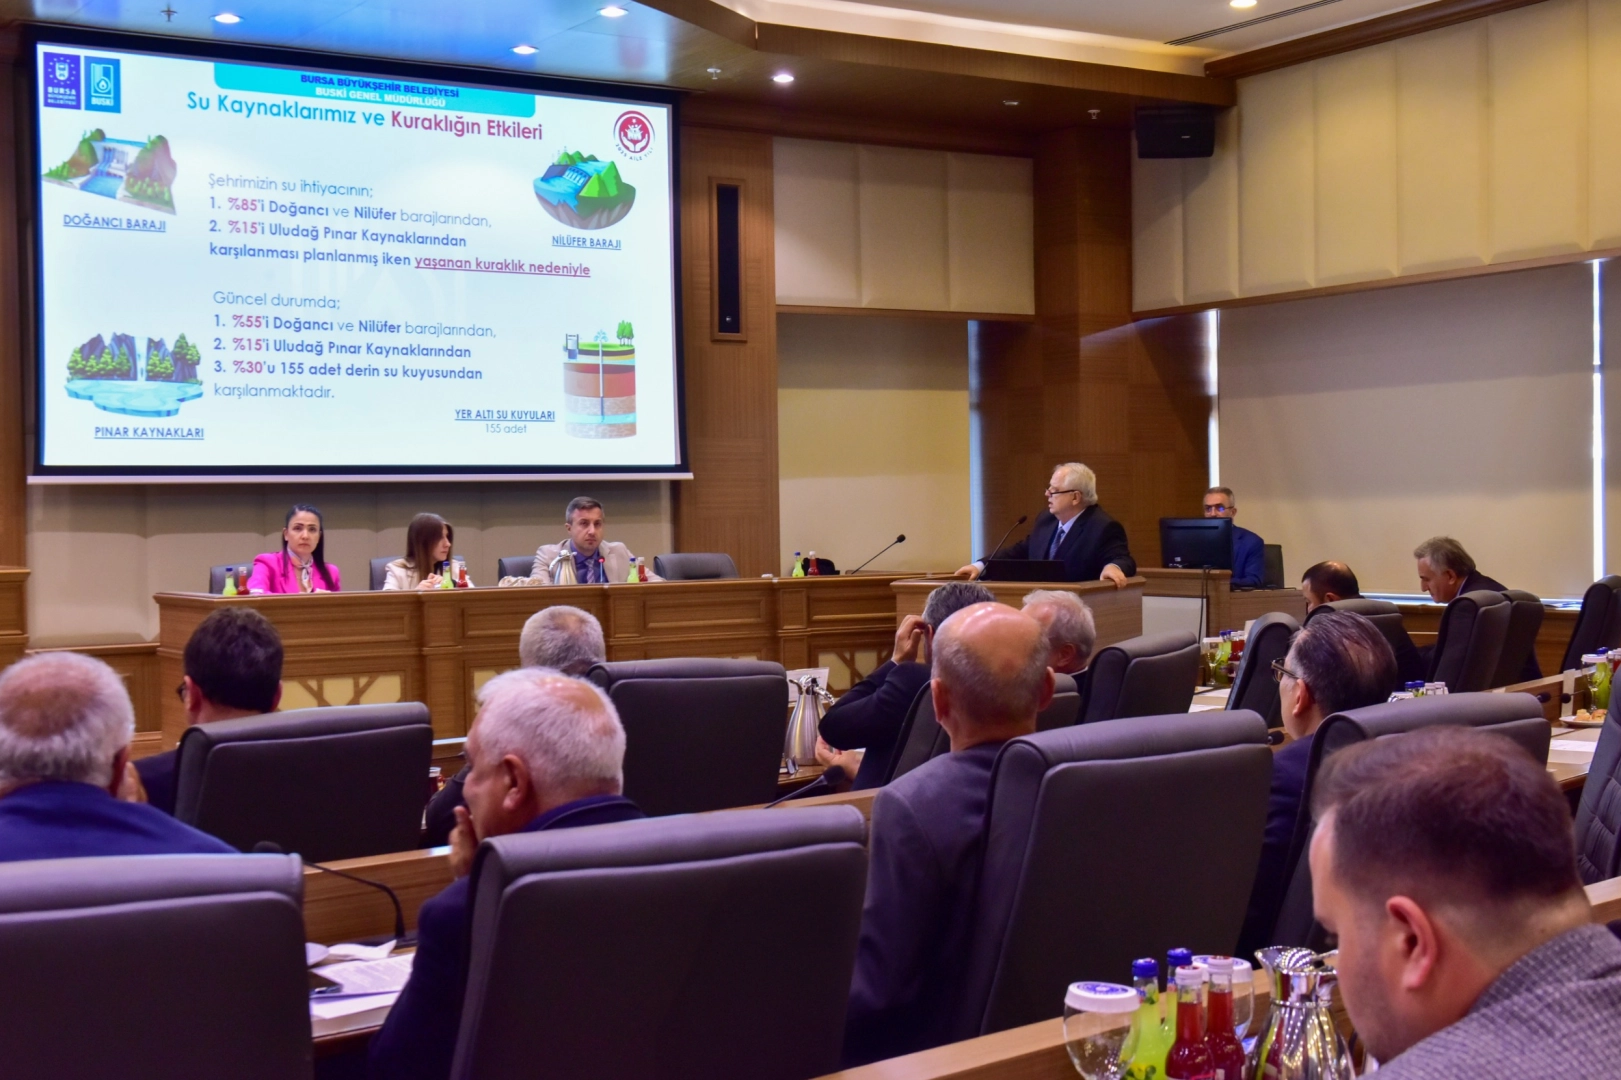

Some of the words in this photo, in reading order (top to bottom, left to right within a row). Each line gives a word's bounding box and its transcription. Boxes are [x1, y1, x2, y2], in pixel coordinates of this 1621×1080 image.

[301, 74, 335, 86] BURSA
[337, 78, 402, 92] BÜYÜKŞEHİR
[404, 84, 460, 98] BELEDİYESİ
[315, 87, 347, 98] BUSKİ
[349, 90, 382, 102] GENEL
[384, 93, 446, 107] MÜDÜRLÜĞÜ
[186, 90, 210, 110] Su
[218, 94, 357, 123] Kaynaklarımız
[363, 111, 386, 127] ve
[392, 110, 480, 138] Kuraklığın
[488, 120, 542, 140] Etkileri
[208, 172, 278, 190] Şehrimizin
[282, 182, 296, 192] su
[300, 180, 374, 198] ihtiyacının;
[270, 200, 328, 218] Doğancı
[332, 208, 350, 218] ve
[354, 206, 396, 220] Nilüfer
[63, 214, 123, 228] DOĞANCI
[126, 218, 166, 231] BARAJI
[270, 222, 320, 242] Uludağ
[324, 226, 358, 240] Pınar
[362, 228, 466, 248] Kaynaklarından
[552, 235, 587, 247] NİLÜFER
[590, 237, 621, 249] BARAJI
[210, 242, 298, 260] karşılanması
[304, 248, 378, 266] planlanmış
[382, 252, 410, 266] iken
[414, 256, 472, 270] yaşanan
[475, 257, 526, 272] kuraklık
[529, 261, 591, 276] nedeniyle
[212, 290, 266, 306] Güncel
[270, 294, 340, 310] durumda;
[274, 316, 334, 332] Doğancı
[336, 322, 354, 332] ve
[358, 320, 402, 334] Nilüfer
[404, 320, 496, 338] barajlarından,
[274, 338, 324, 356] Uludağ
[328, 340, 362, 354] Pınar
[366, 342, 472, 358] Kaynaklarından
[280, 362, 304, 374] 155
[308, 362, 342, 376] adet
[346, 364, 380, 376] derin
[384, 368, 398, 378] su
[402, 364, 482, 380] kuyusundan
[214, 382, 334, 400] karşılanmaktadır.
[455, 409, 472, 419] YER
[475, 409, 494, 419] ALTI
[496, 410, 508, 420] SU
[510, 410, 555, 420] KUYULARI
[95, 427, 129, 437] PINAR
[133, 427, 204, 438] KAYNAKLARI
[486, 424, 502, 434] 155
[504, 424, 528, 434] adet
